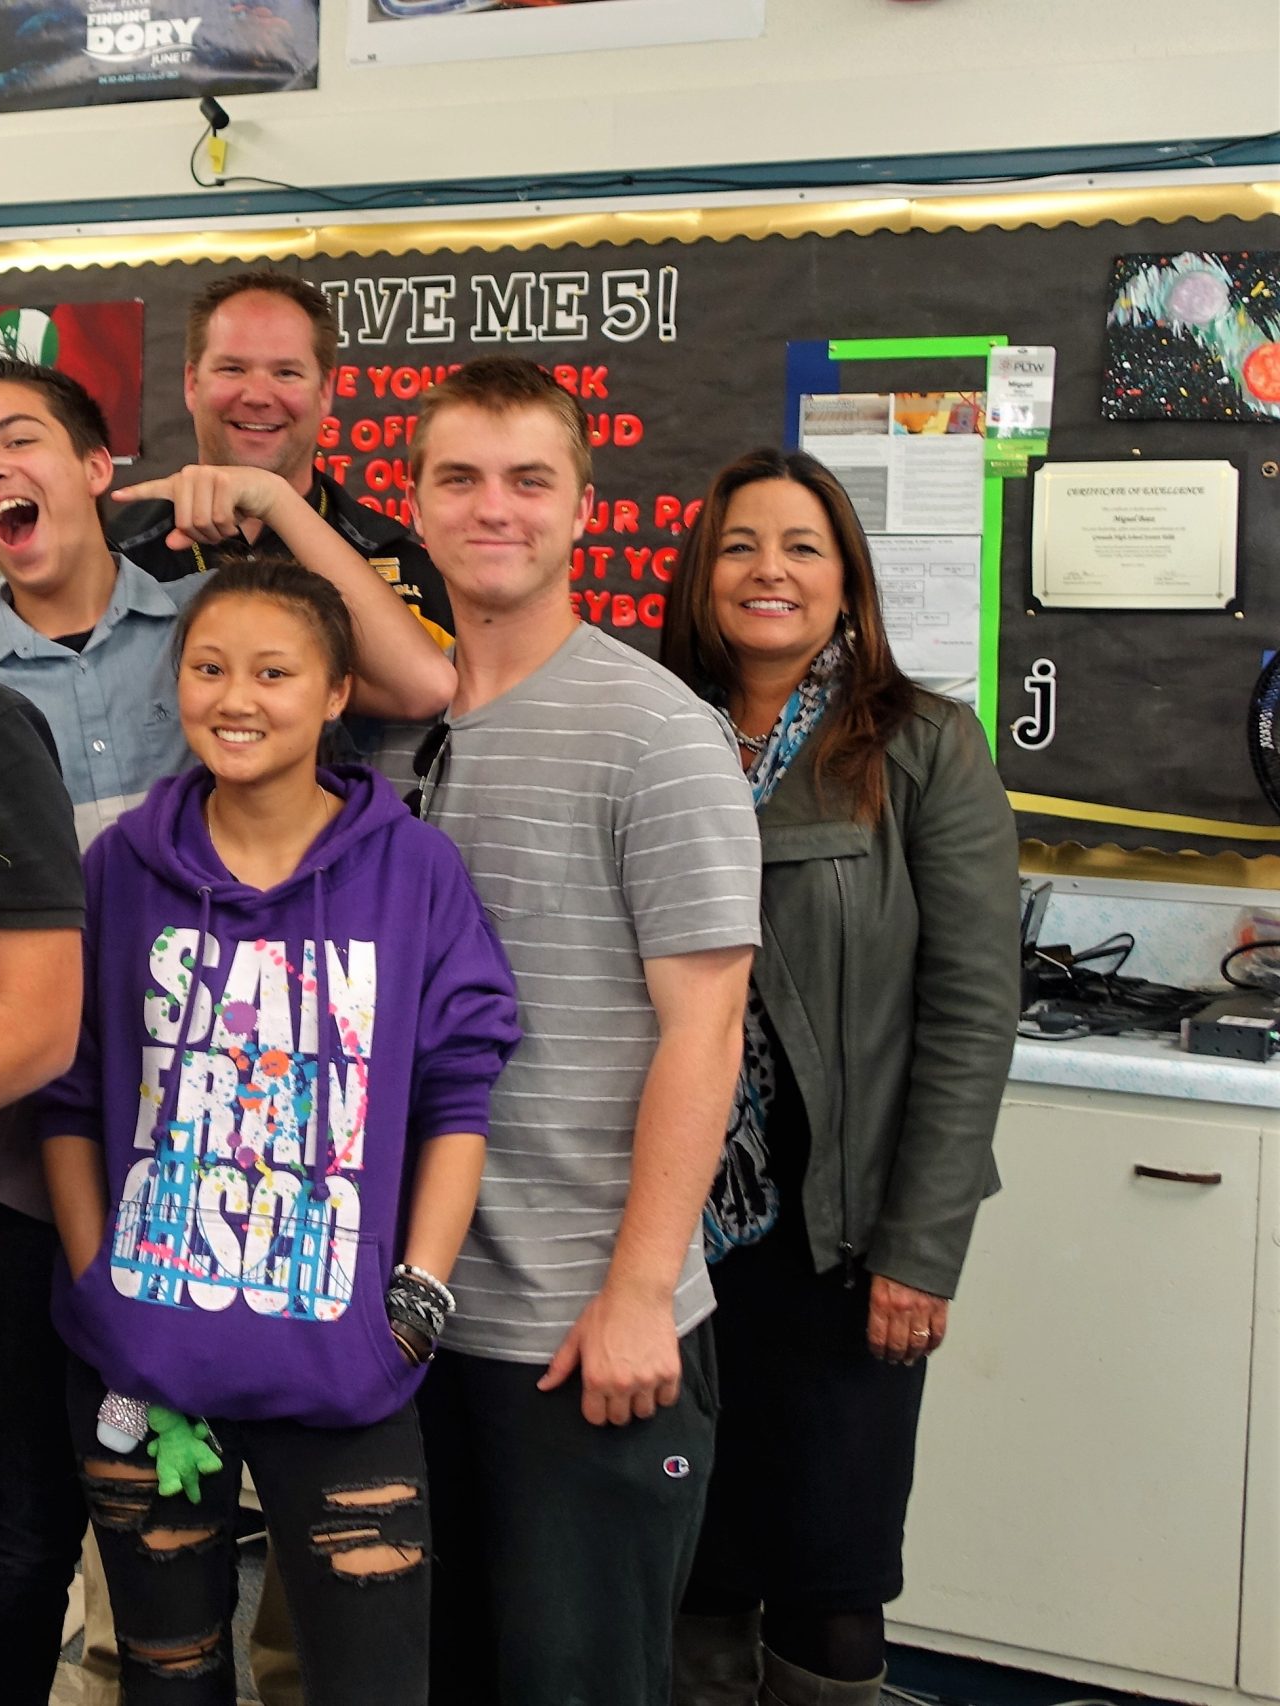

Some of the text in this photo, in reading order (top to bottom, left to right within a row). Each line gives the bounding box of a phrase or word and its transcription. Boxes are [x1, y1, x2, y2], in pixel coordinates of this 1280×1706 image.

[86, 17, 202, 54] DORY
[87, 8, 151, 27] FINDING
[151, 52, 180, 68] JUNE
[317, 264, 679, 348] IVE ME 5!
[1012, 657, 1057, 751] j
[143, 926, 378, 1058] SAN
[133, 1046, 369, 1170] FRAN
[109, 1157, 362, 1322] CISCO
